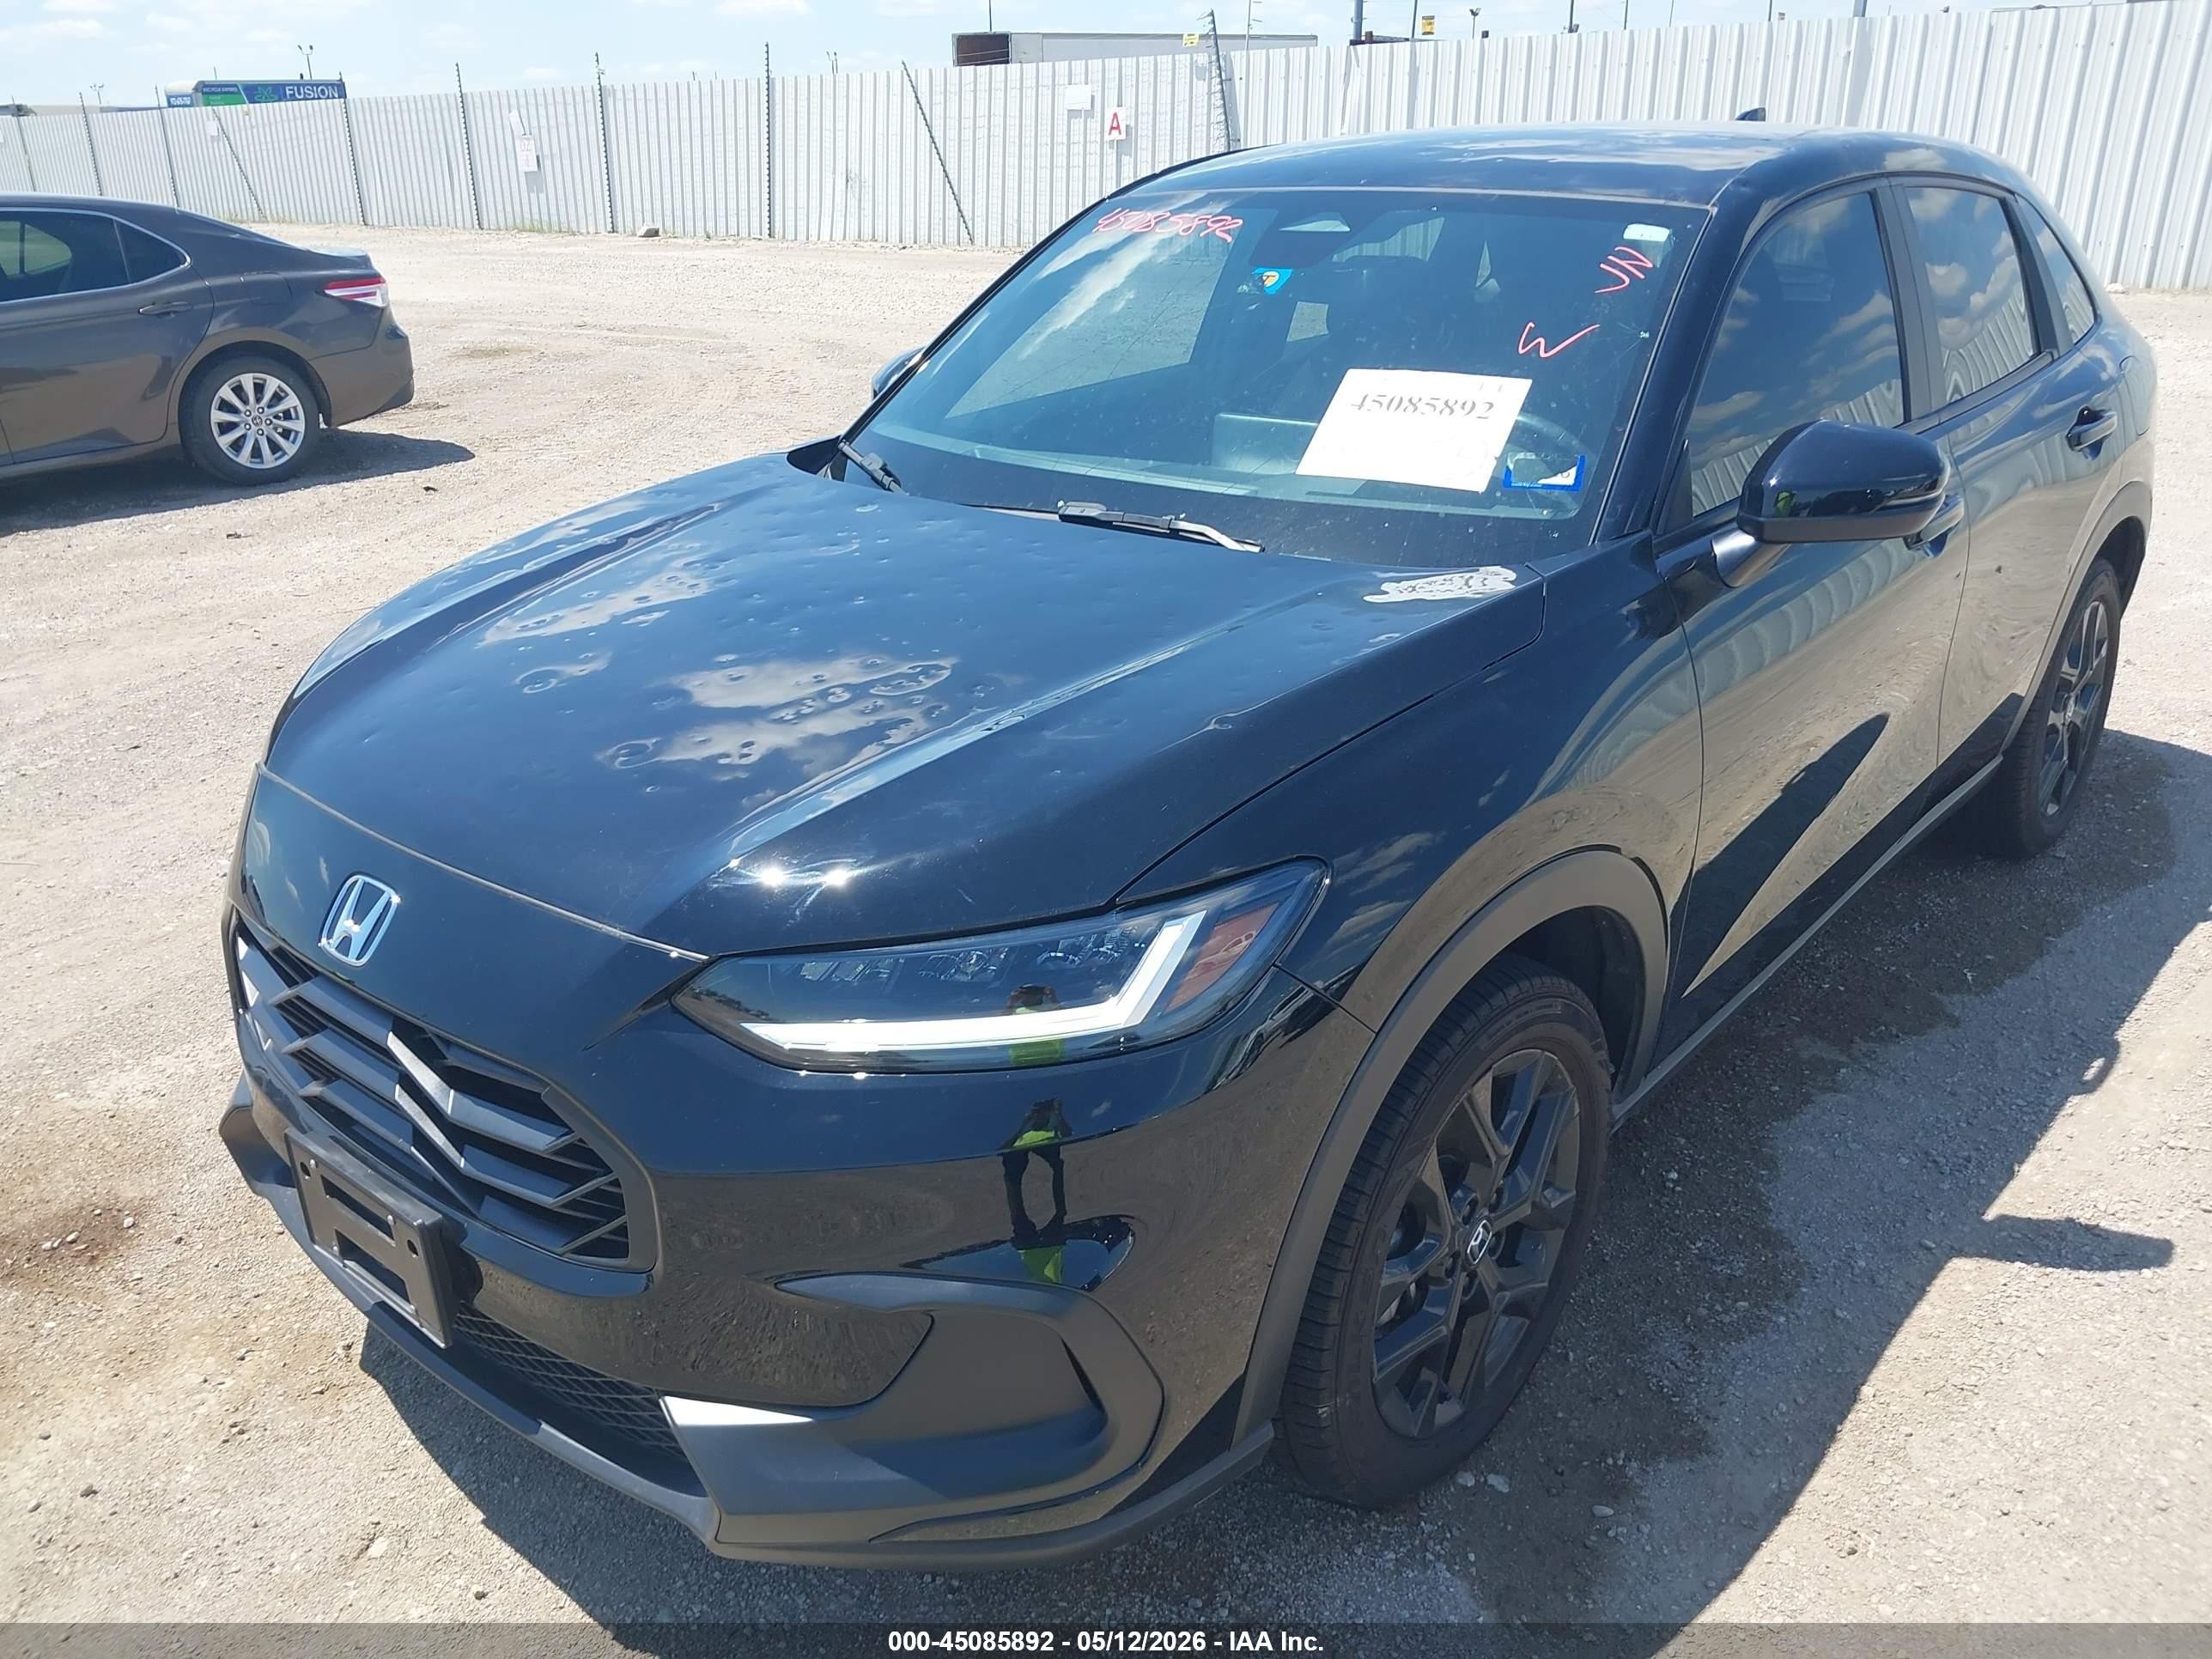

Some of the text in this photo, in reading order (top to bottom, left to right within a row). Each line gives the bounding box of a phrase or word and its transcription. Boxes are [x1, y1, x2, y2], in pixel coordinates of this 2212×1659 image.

[285, 85, 339, 100] FUSION
[1108, 112, 1122, 136] A
[1091, 207, 1243, 243] 45085892
[1351, 393, 1495, 420] 45085892
